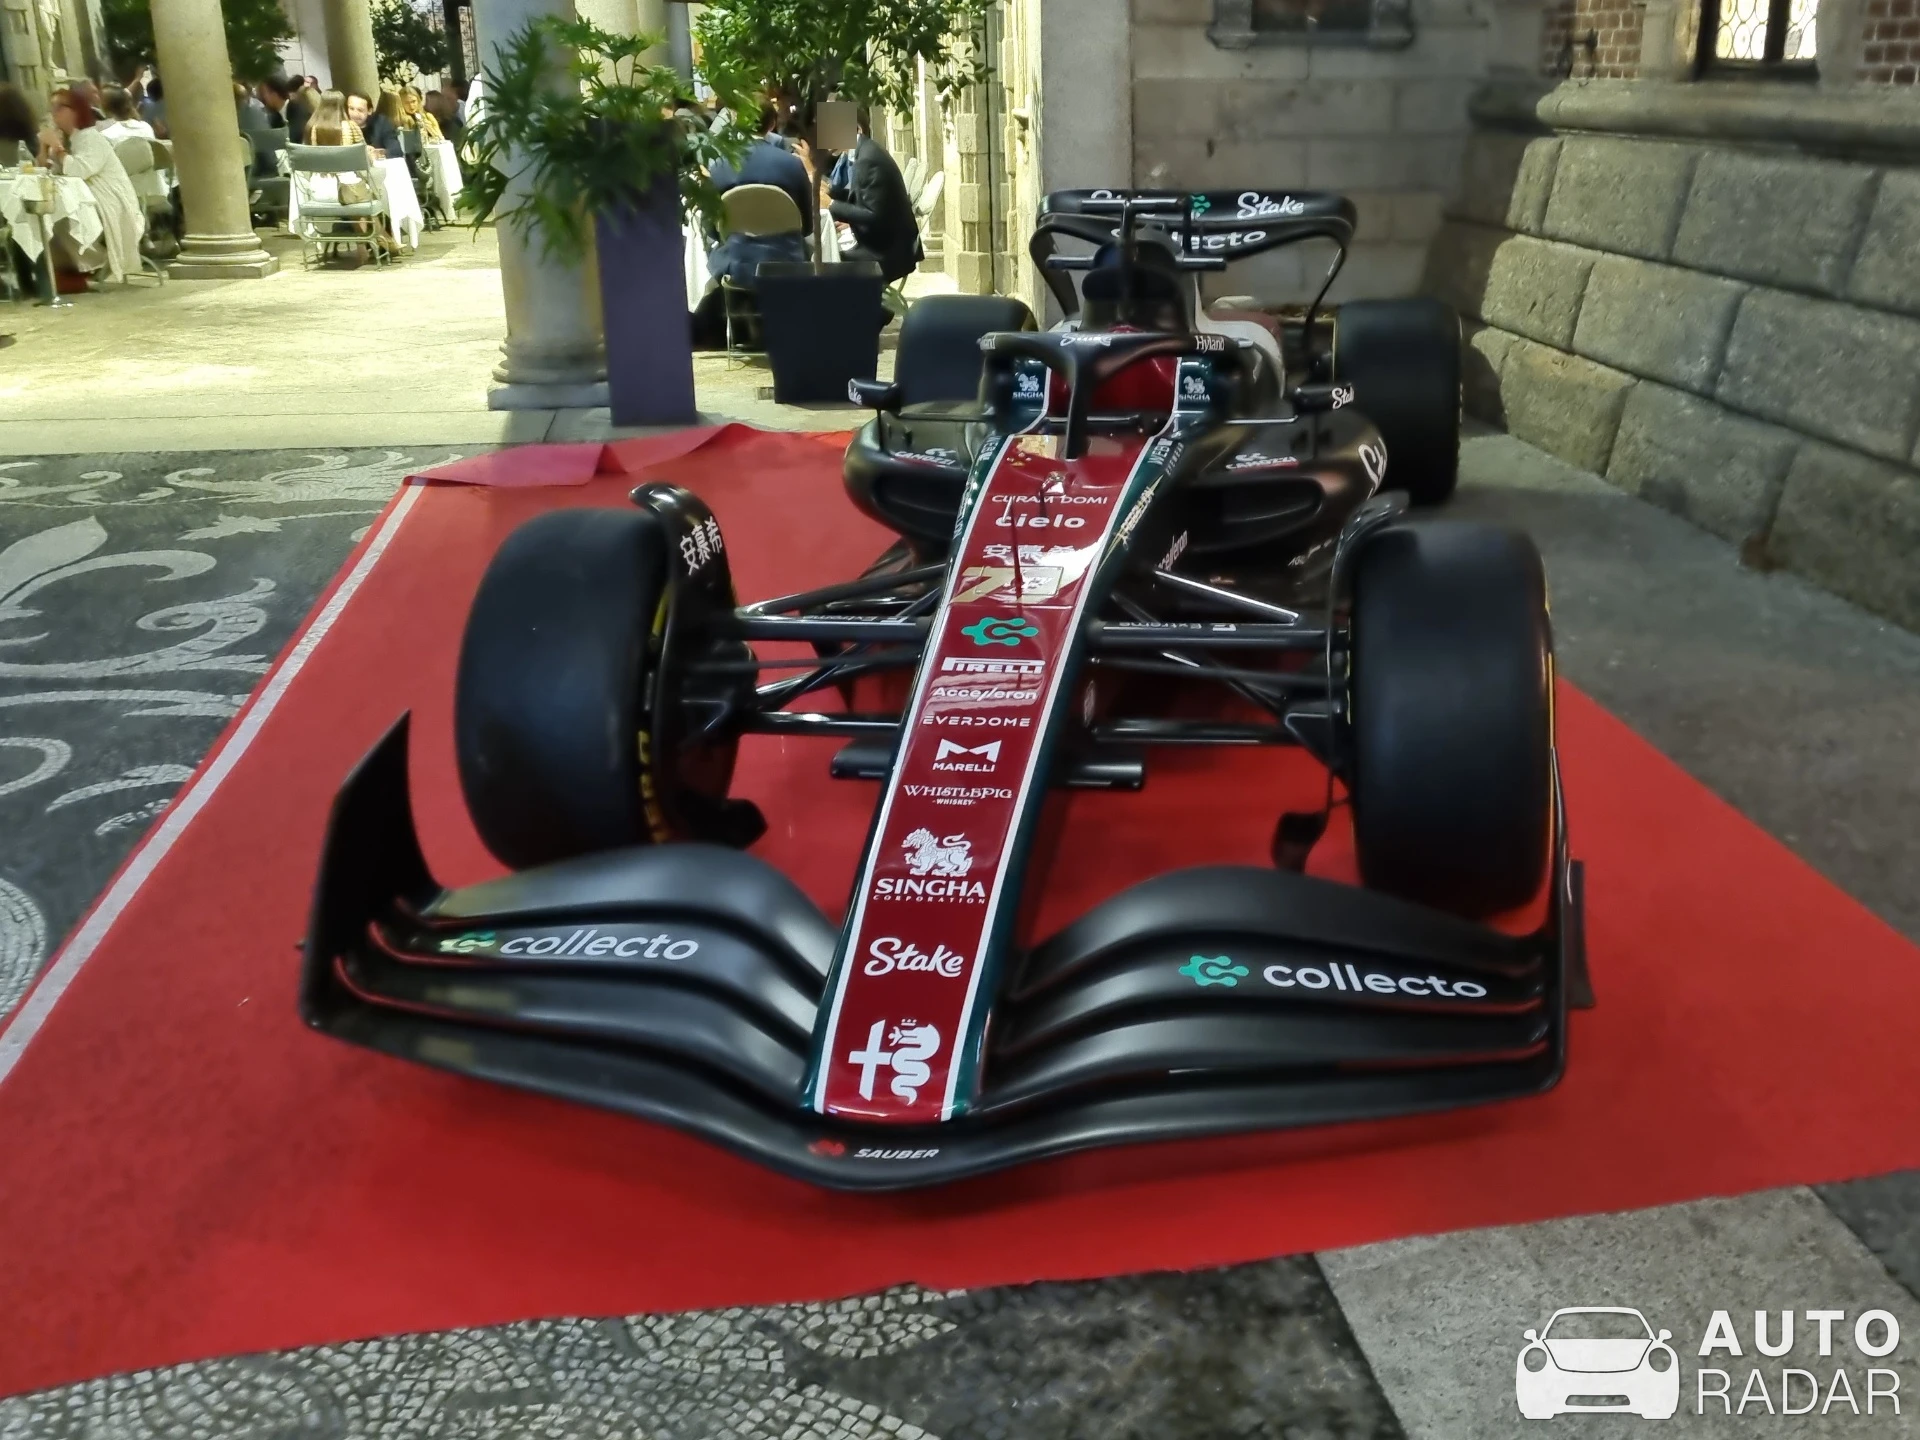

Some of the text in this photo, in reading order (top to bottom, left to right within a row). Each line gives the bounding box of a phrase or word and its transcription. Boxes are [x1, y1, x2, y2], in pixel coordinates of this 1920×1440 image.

[1236, 192, 1304, 219] Stake
[1013, 391, 1044, 399] SINGHA
[1061, 496, 1108, 504] DOMI
[995, 513, 1086, 528] cielo
[941, 656, 1046, 675] PIRELLI
[922, 715, 1031, 727] EVERDOME
[932, 762, 996, 773] MARELLI
[875, 878, 986, 898] SINGHA
[873, 895, 985, 905] CORPORATION
[499, 929, 699, 960] collecto
[864, 937, 964, 978] Stake
[1263, 962, 1488, 998] collecto
[854, 1148, 939, 1160] SAUBER
